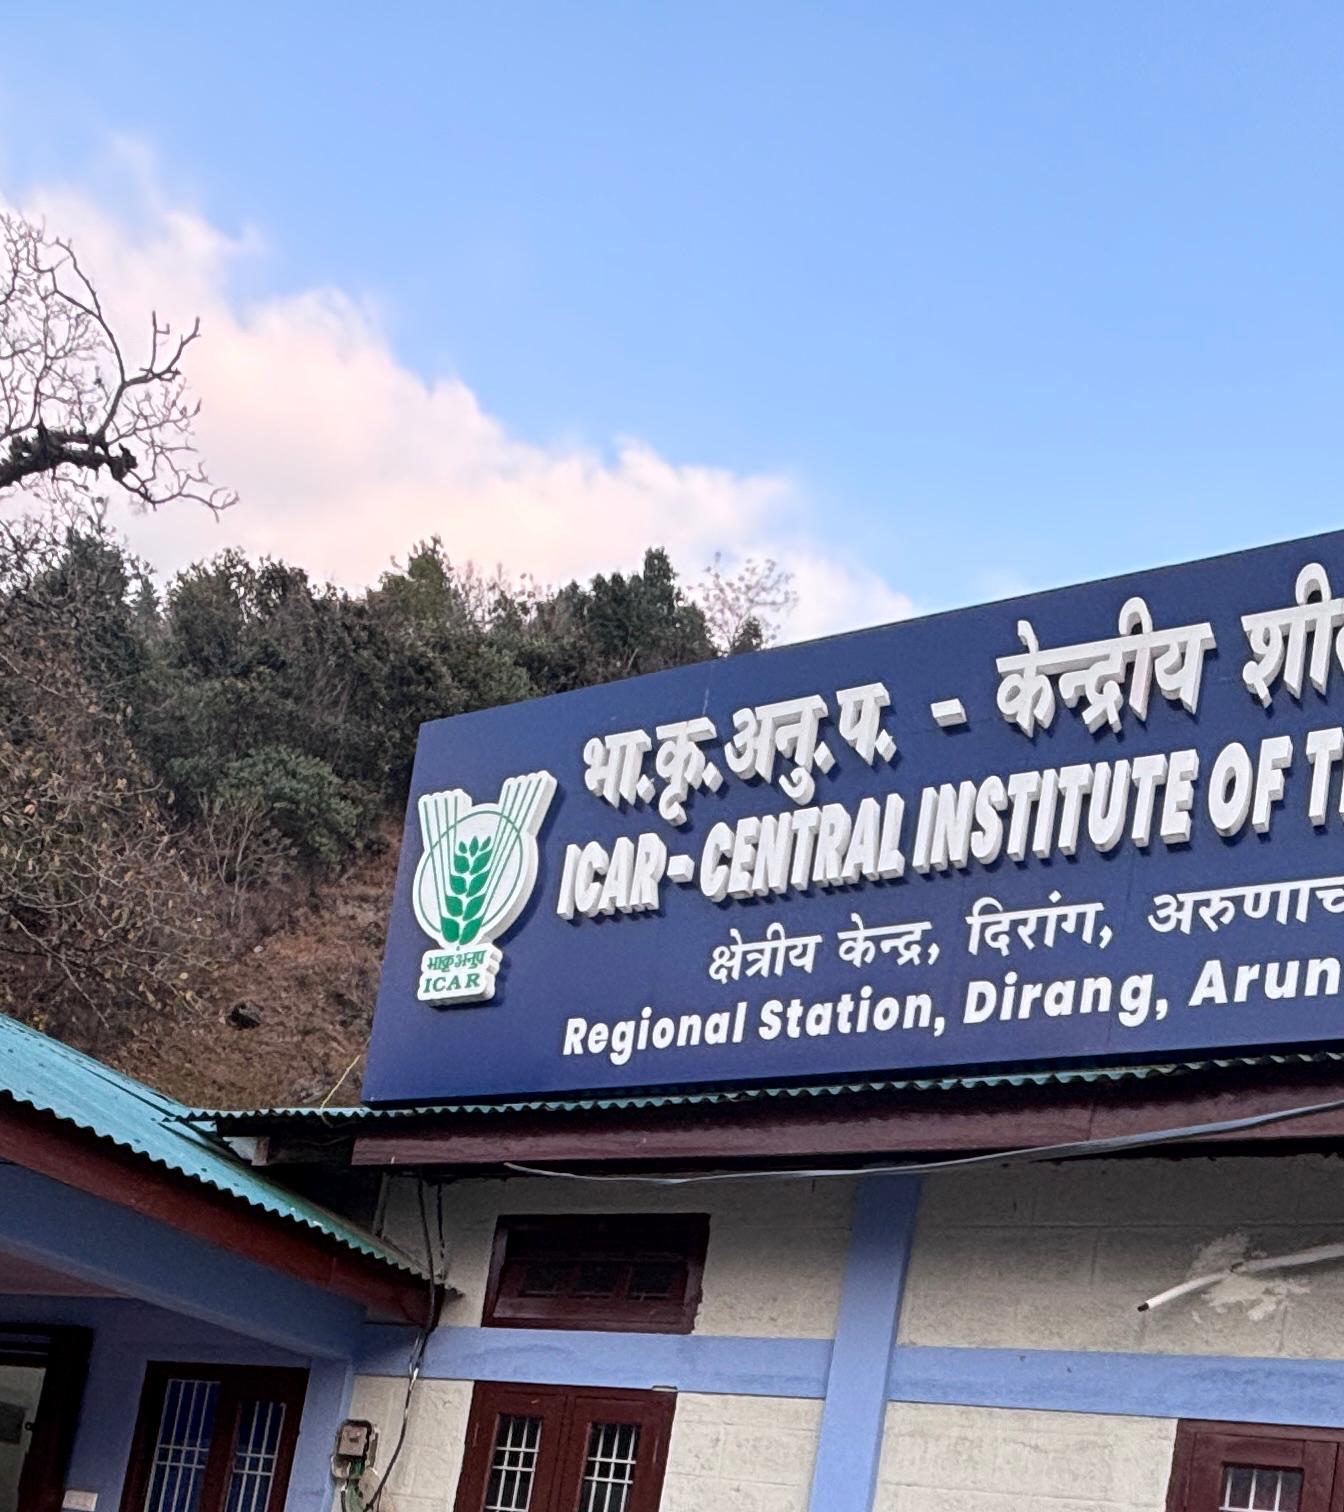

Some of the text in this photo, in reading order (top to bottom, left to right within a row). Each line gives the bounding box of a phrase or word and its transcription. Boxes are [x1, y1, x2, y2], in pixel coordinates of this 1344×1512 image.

[995, 596, 1217, 737] केन्द्रीय
[911, 748, 1200, 875] INSTITUTE
[1207, 735, 1294, 837] OF
[423, 972, 480, 993] ICAR
[708, 921, 824, 985] क्षेत्रीय
[836, 912, 941, 968] केन्द्र,
[964, 890, 1113, 957] दिरांग,
[562, 999, 748, 1066] Regional
[758, 985, 946, 1041] Station,
[962, 971, 1169, 1024] Dirang,
